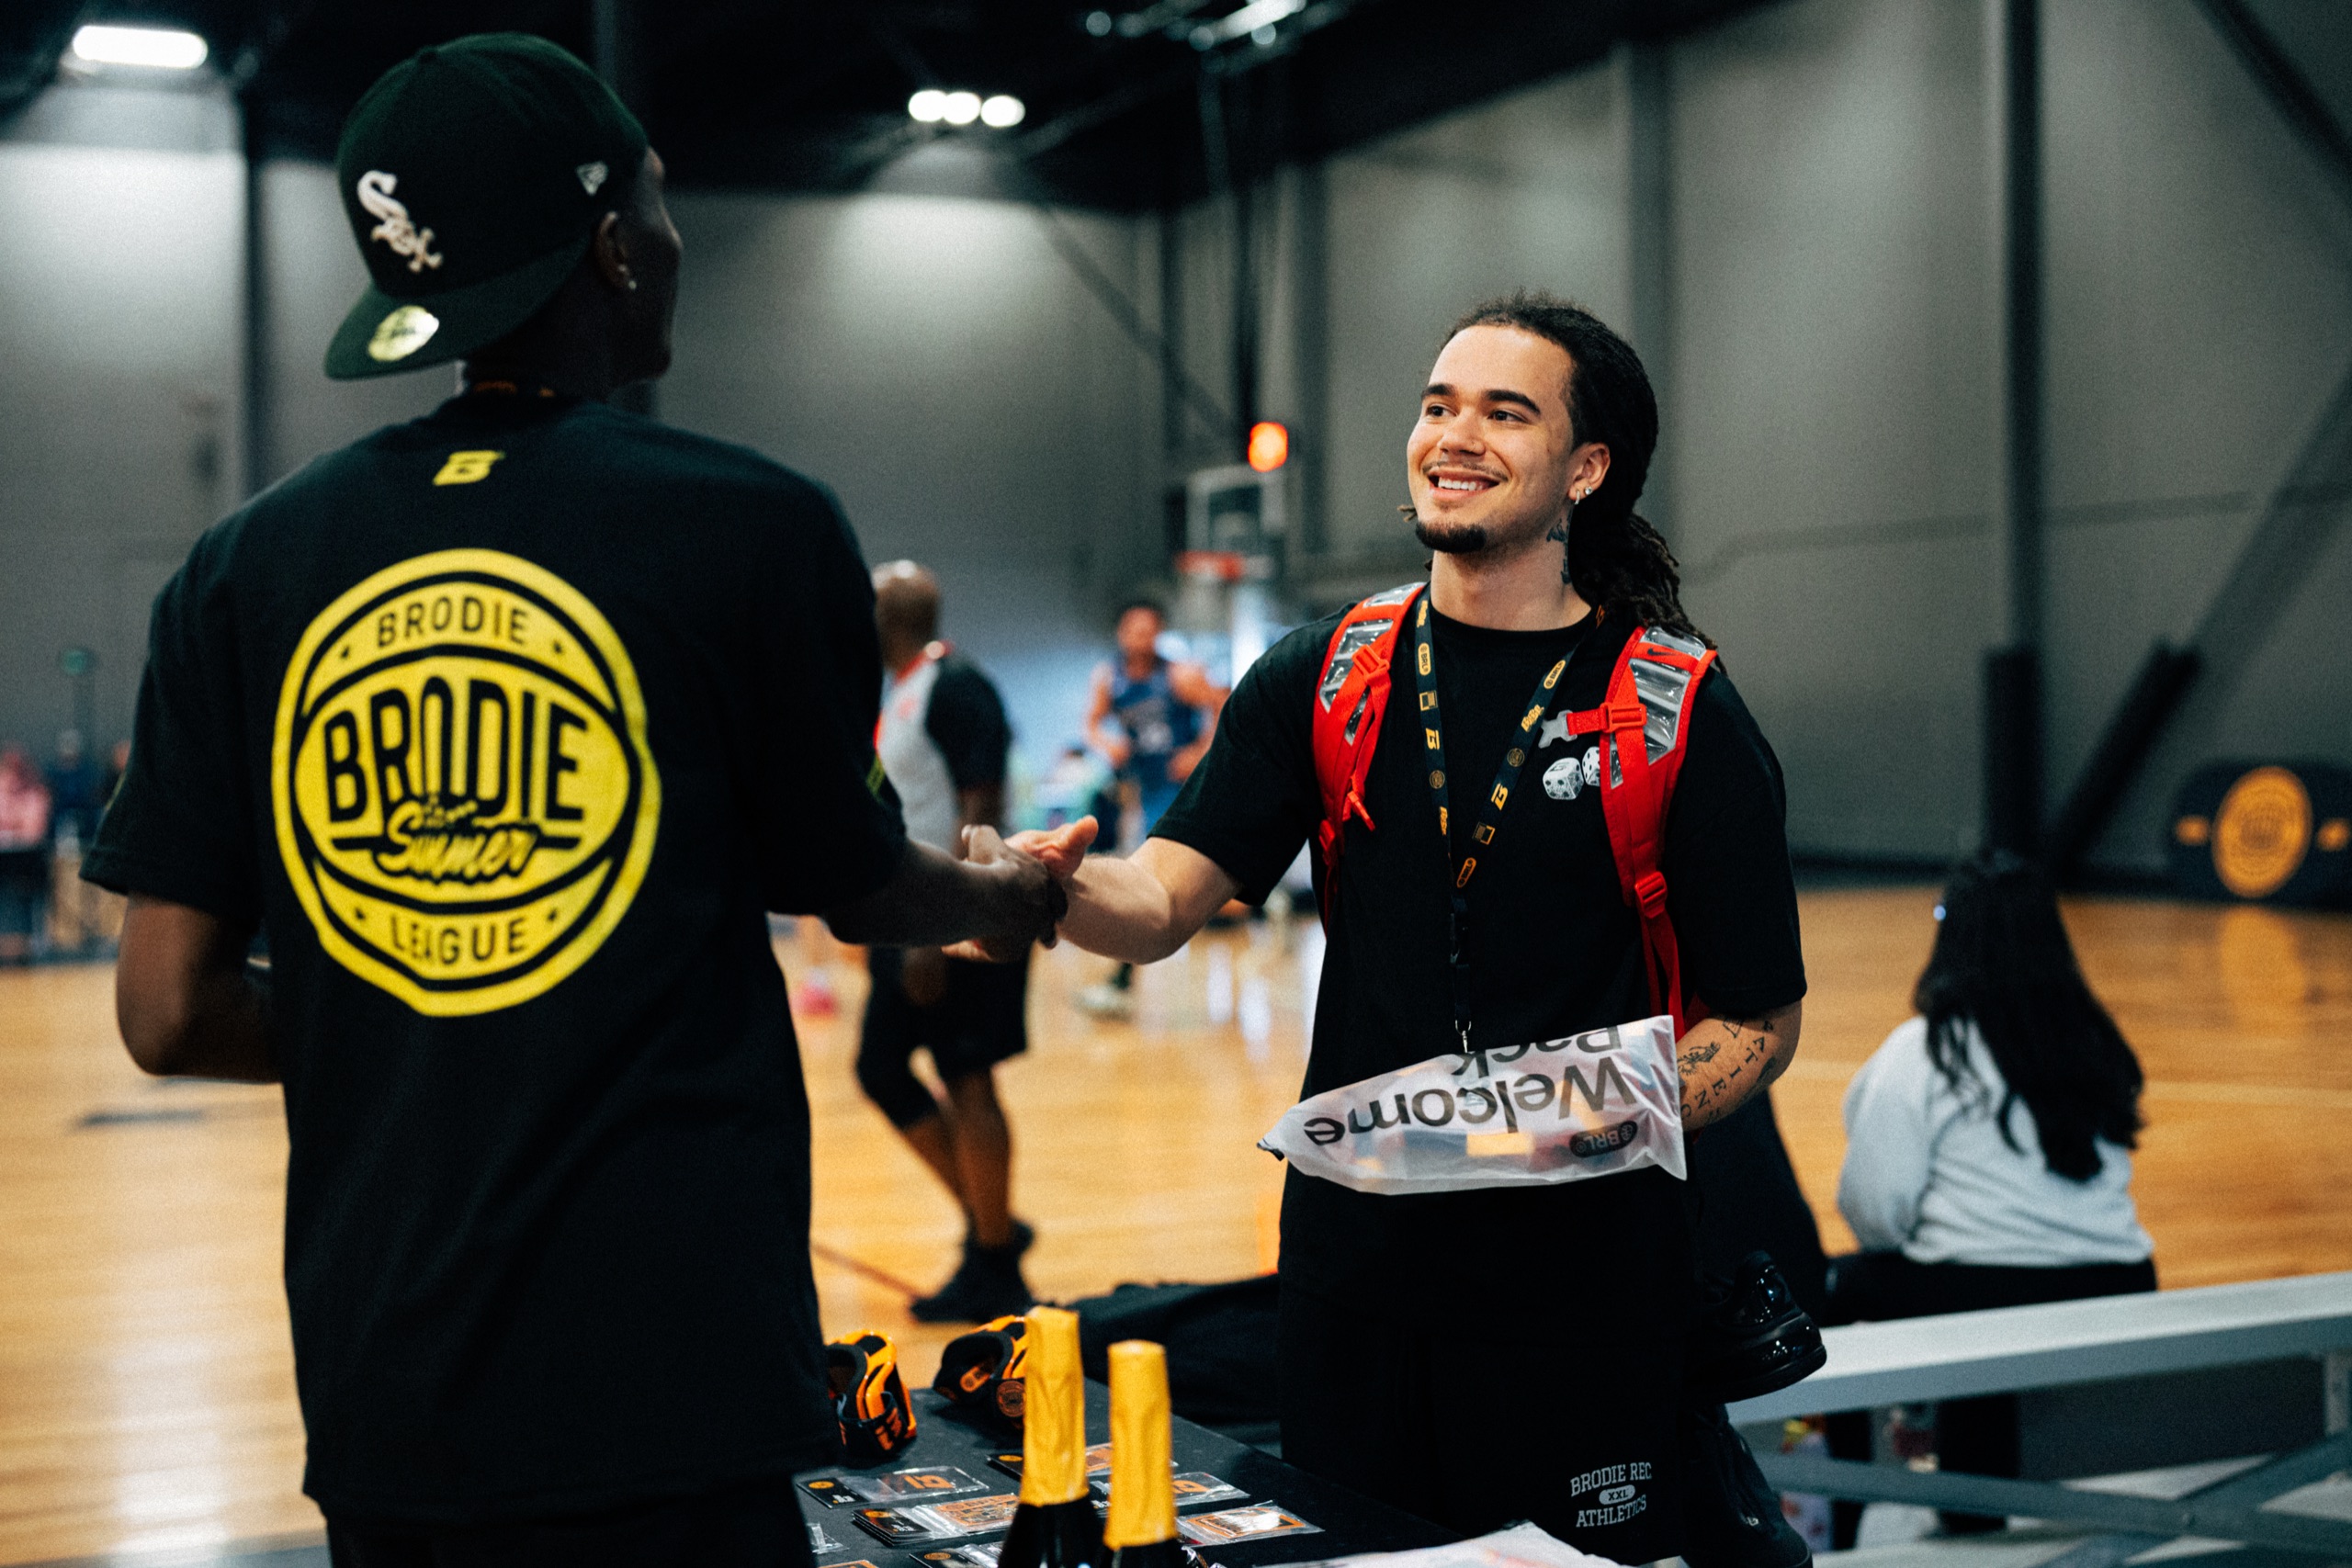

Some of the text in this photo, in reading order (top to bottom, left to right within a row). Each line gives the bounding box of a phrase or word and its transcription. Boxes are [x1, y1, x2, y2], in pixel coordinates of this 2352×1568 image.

[376, 596, 530, 649] BRODIE
[323, 675, 590, 824] BRODIE
[1304, 1056, 1637, 1145] Welcome
[1583, 1129, 1621, 1147] BRL
[1570, 1462, 1652, 1497] BRODIE REC
[1608, 1488, 1629, 1502] XXL
[1576, 1494, 1647, 1528] ATHLETICS
